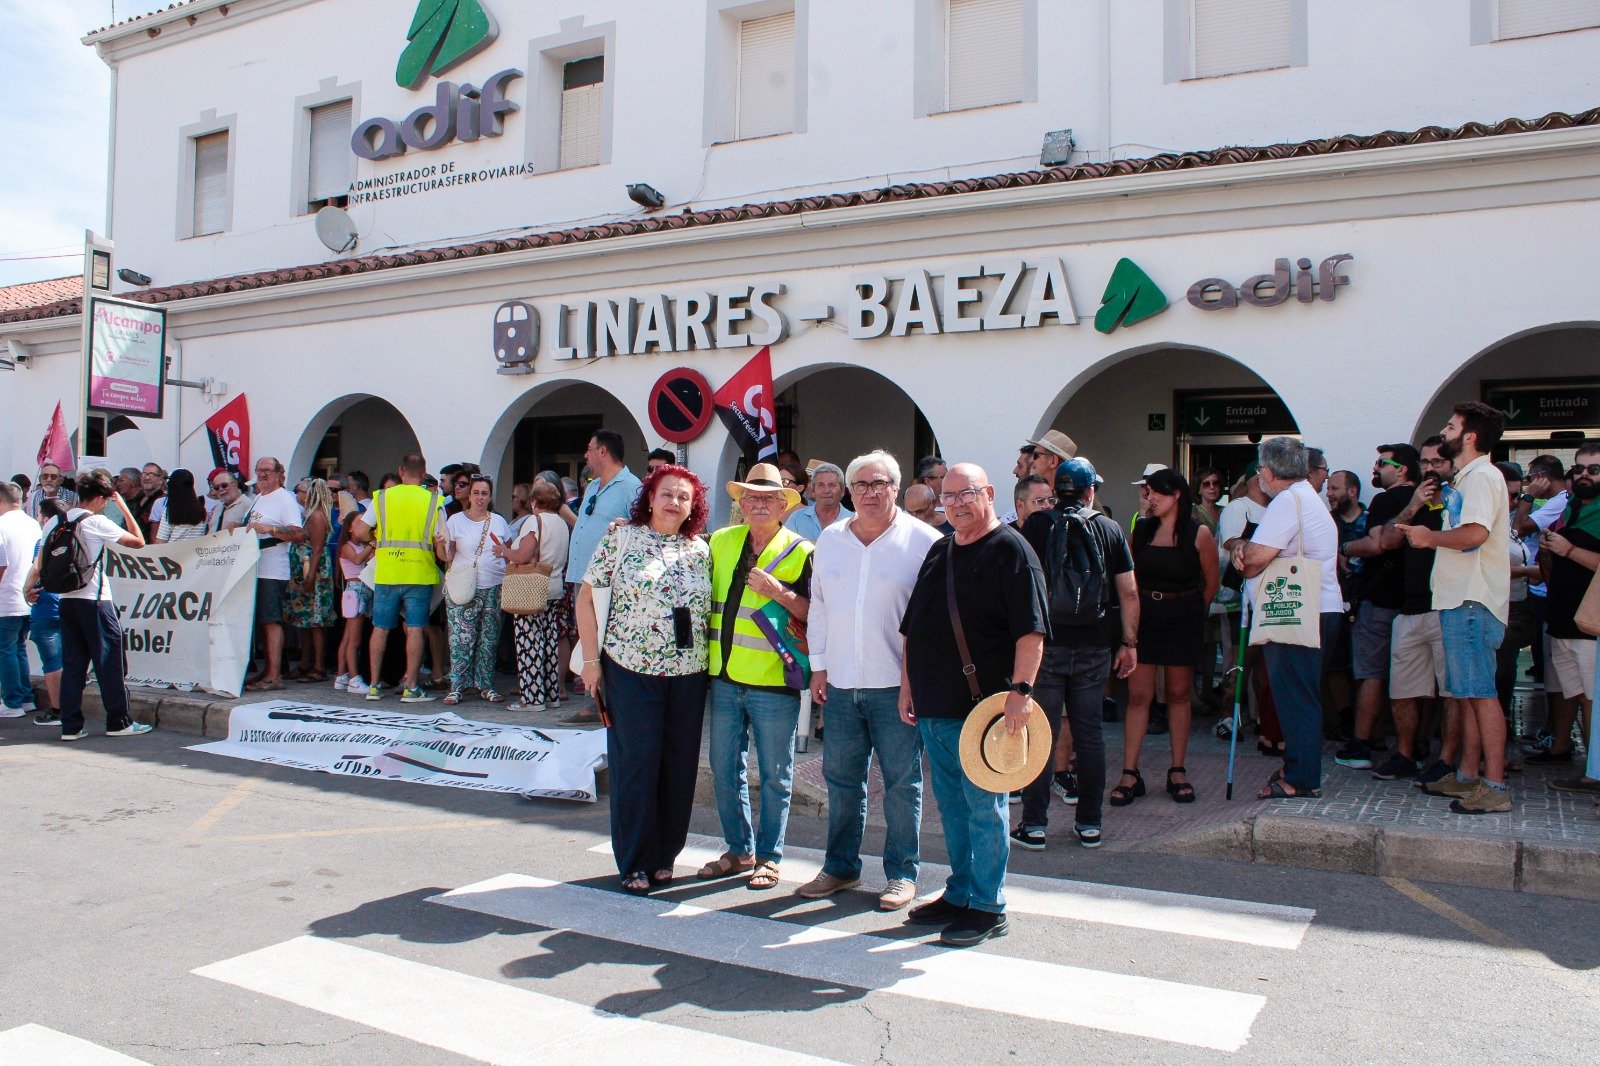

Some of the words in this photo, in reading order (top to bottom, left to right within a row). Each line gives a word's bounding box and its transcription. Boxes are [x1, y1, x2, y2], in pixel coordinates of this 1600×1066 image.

[351, 68, 523, 160] adif
[349, 166, 436, 192] ADMINISTRADOR
[441, 162, 455, 174] DE
[1186, 253, 1353, 311] adif
[95, 305, 162, 335] Alcampo
[554, 283, 788, 361] LINARES
[849, 257, 1079, 340] BAEZA
[1226, 405, 1267, 416] Entrada
[1540, 396, 1588, 408] Entrada
[130, 591, 213, 621] LORCA
[122, 628, 173, 654] ible!
[349, 732, 390, 746] CONTRA
